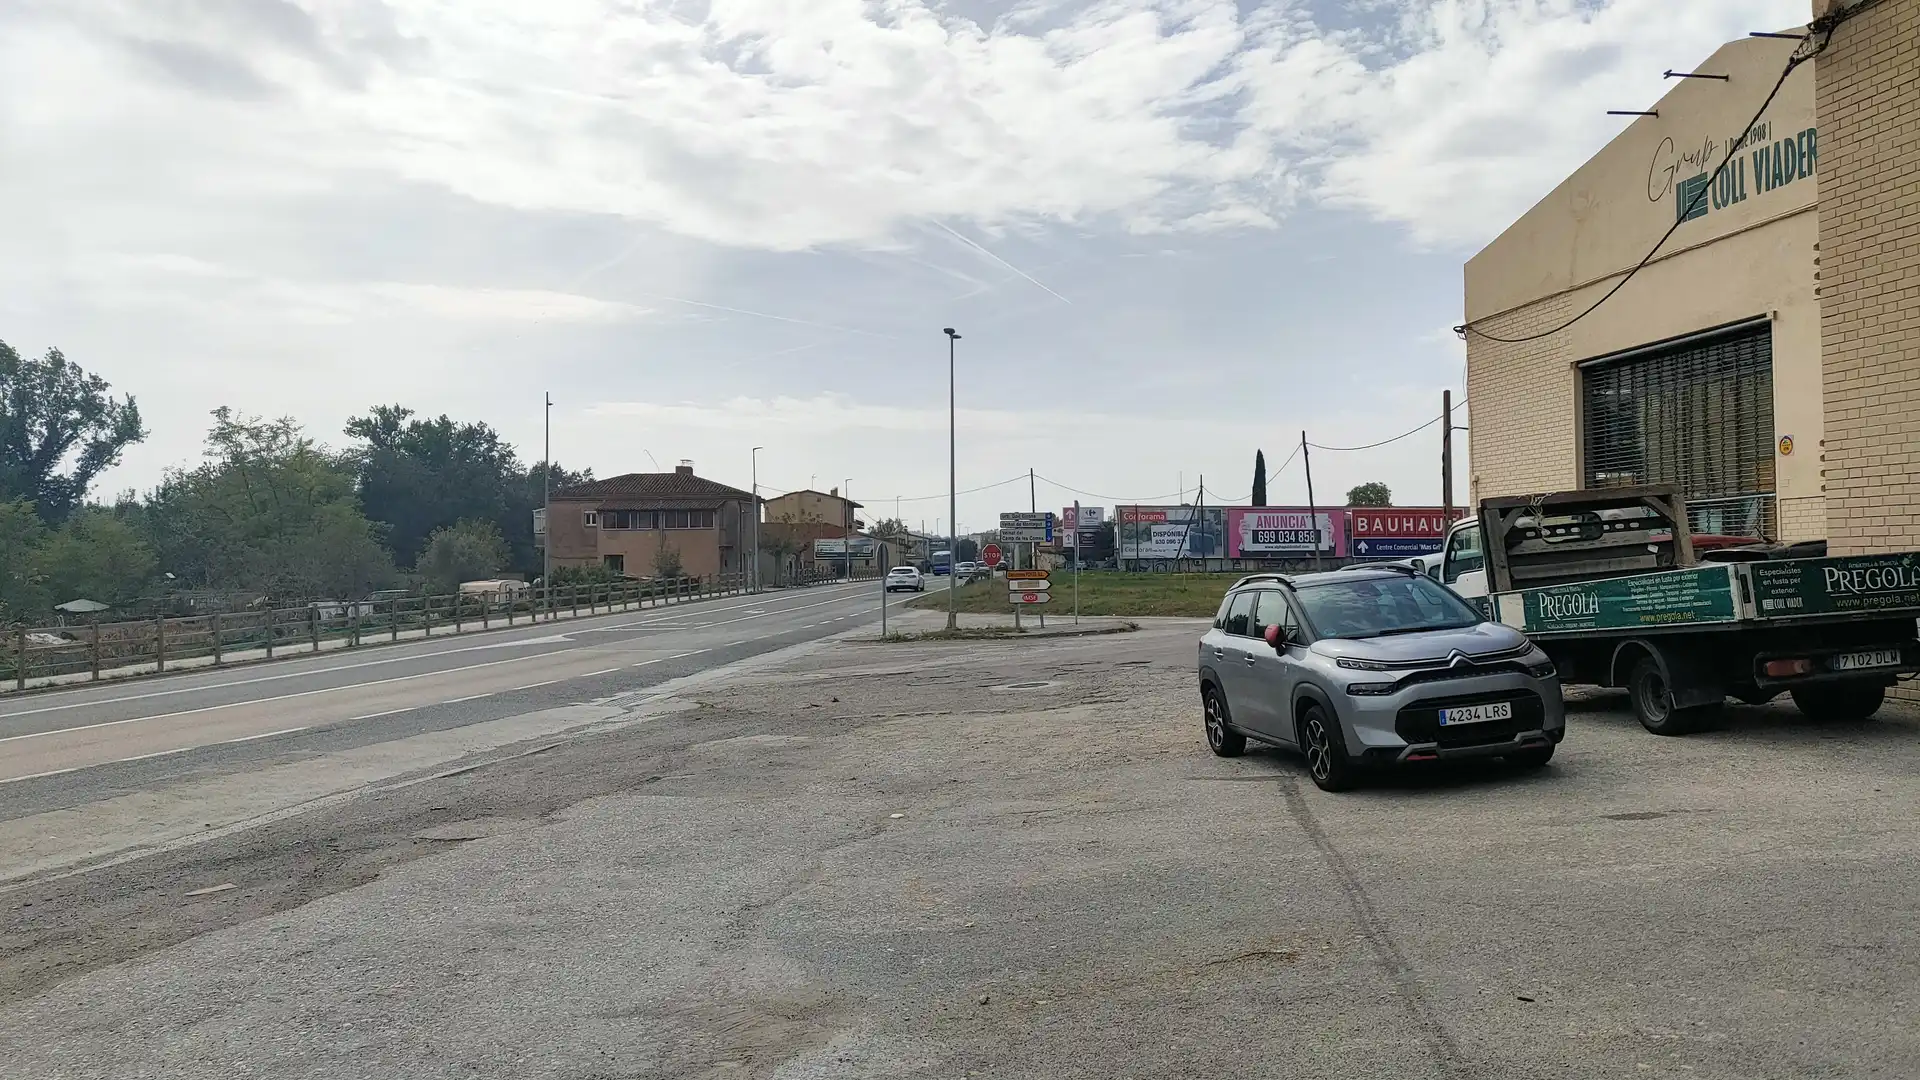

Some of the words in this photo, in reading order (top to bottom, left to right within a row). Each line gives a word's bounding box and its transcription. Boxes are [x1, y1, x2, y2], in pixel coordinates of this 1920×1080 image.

[1750, 123, 1767, 146] 1908
[1647, 135, 1719, 203] Grup
[1711, 156, 1748, 210] COLL
[1752, 128, 1818, 196] VIADER
[1258, 530, 1276, 543] 699
[1278, 530, 1296, 543] 034
[1298, 530, 1316, 543] 858
[1376, 542, 1392, 550] Centre
[1393, 542, 1419, 550] Comercial
[1822, 565, 1920, 595] PREGOLA
[1537, 591, 1600, 620] PREGOLA
[1836, 592, 1920, 608] www.pregola.net
[1640, 610, 1696, 623] www.pregola.net
[1841, 653, 1872, 669] 7102
[1876, 651, 1898, 665] DLM
[1448, 707, 1480, 723] 4234
[1484, 704, 1508, 719] LRS
